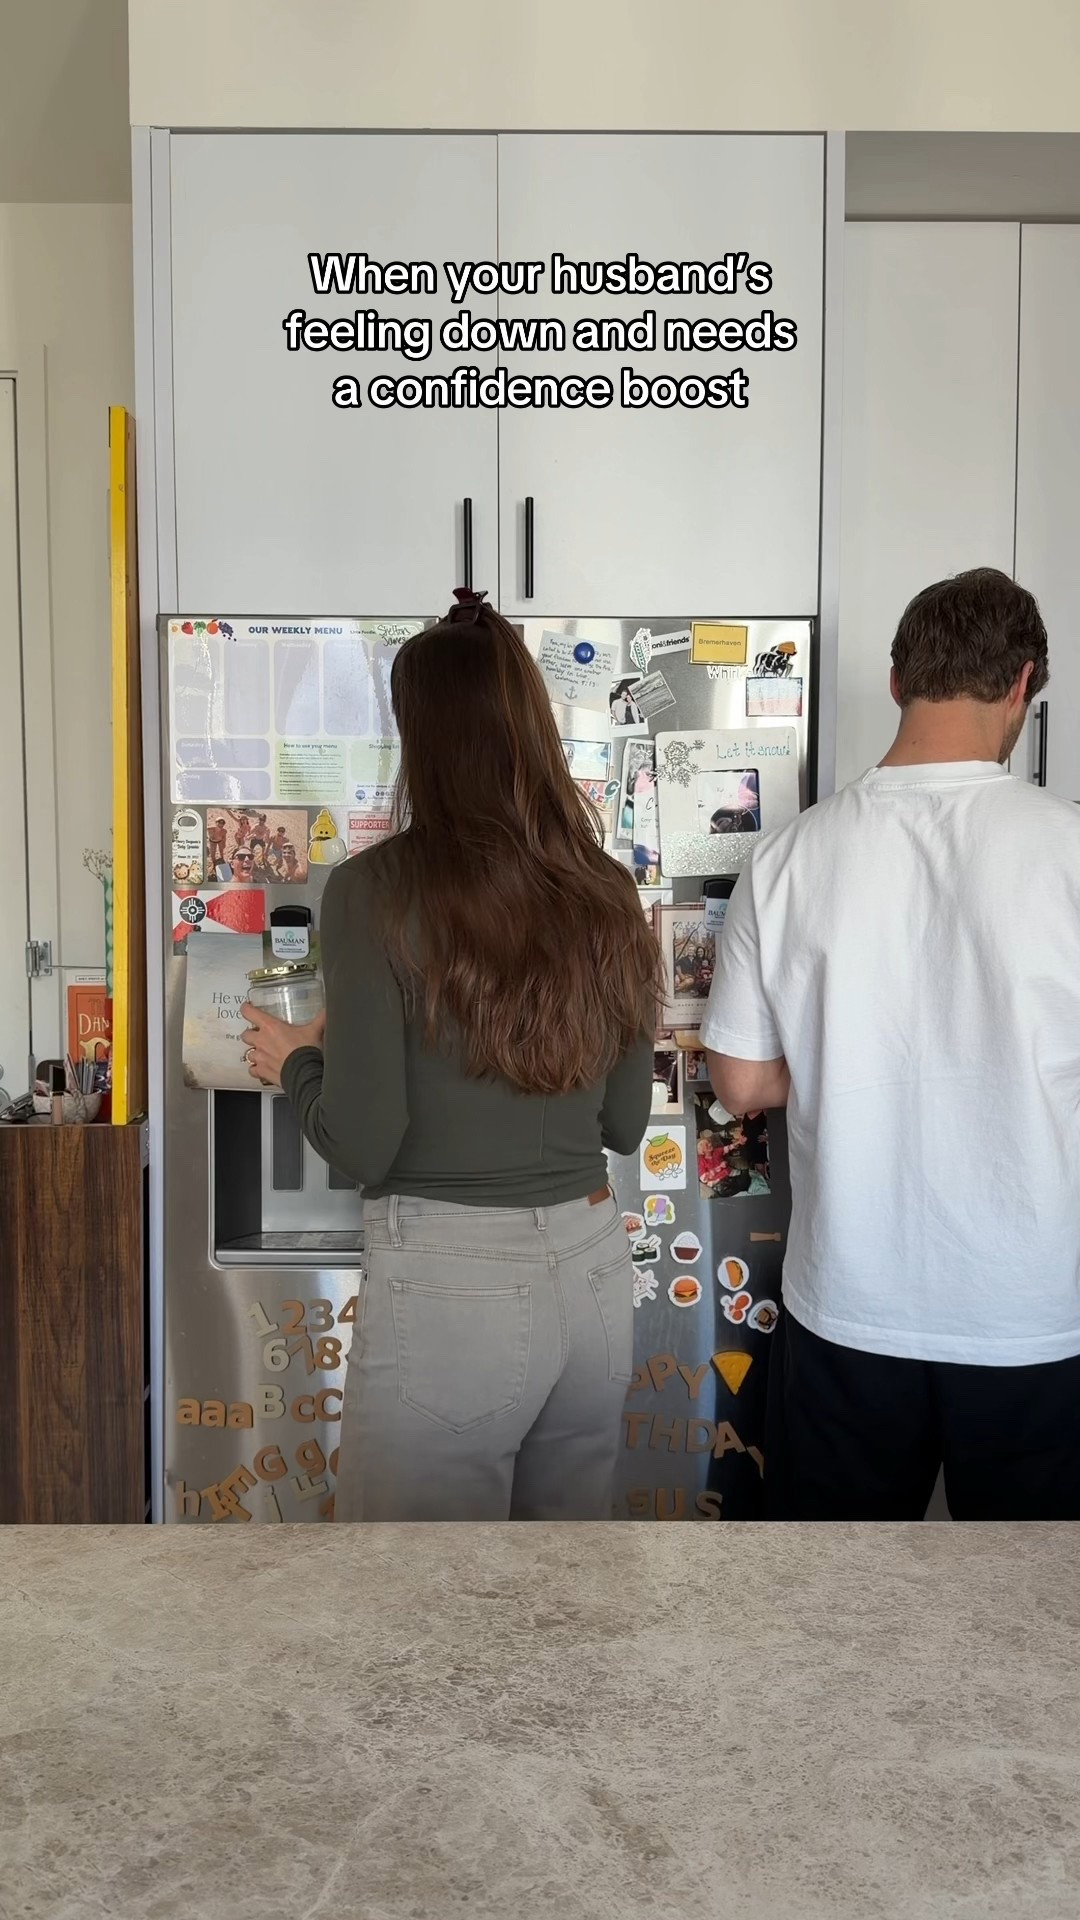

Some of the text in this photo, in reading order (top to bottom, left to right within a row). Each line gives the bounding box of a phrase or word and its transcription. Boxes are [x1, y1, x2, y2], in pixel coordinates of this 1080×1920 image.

[248, 626, 343, 635] OUR WEEKLY MENU
[651, 636, 690, 649] oni&friends
[698, 638, 742, 647] Bremerhaven
[716, 743, 740, 759] Let
[745, 741, 756, 758] it
[350, 820, 391, 830] SUPPORTER
[212, 991, 231, 1005] He
[79, 1013, 110, 1035] DAN
[625, 1353, 709, 1401] PPY
[622, 1411, 748, 1460] THDA
[626, 1486, 724, 1521] SUS
